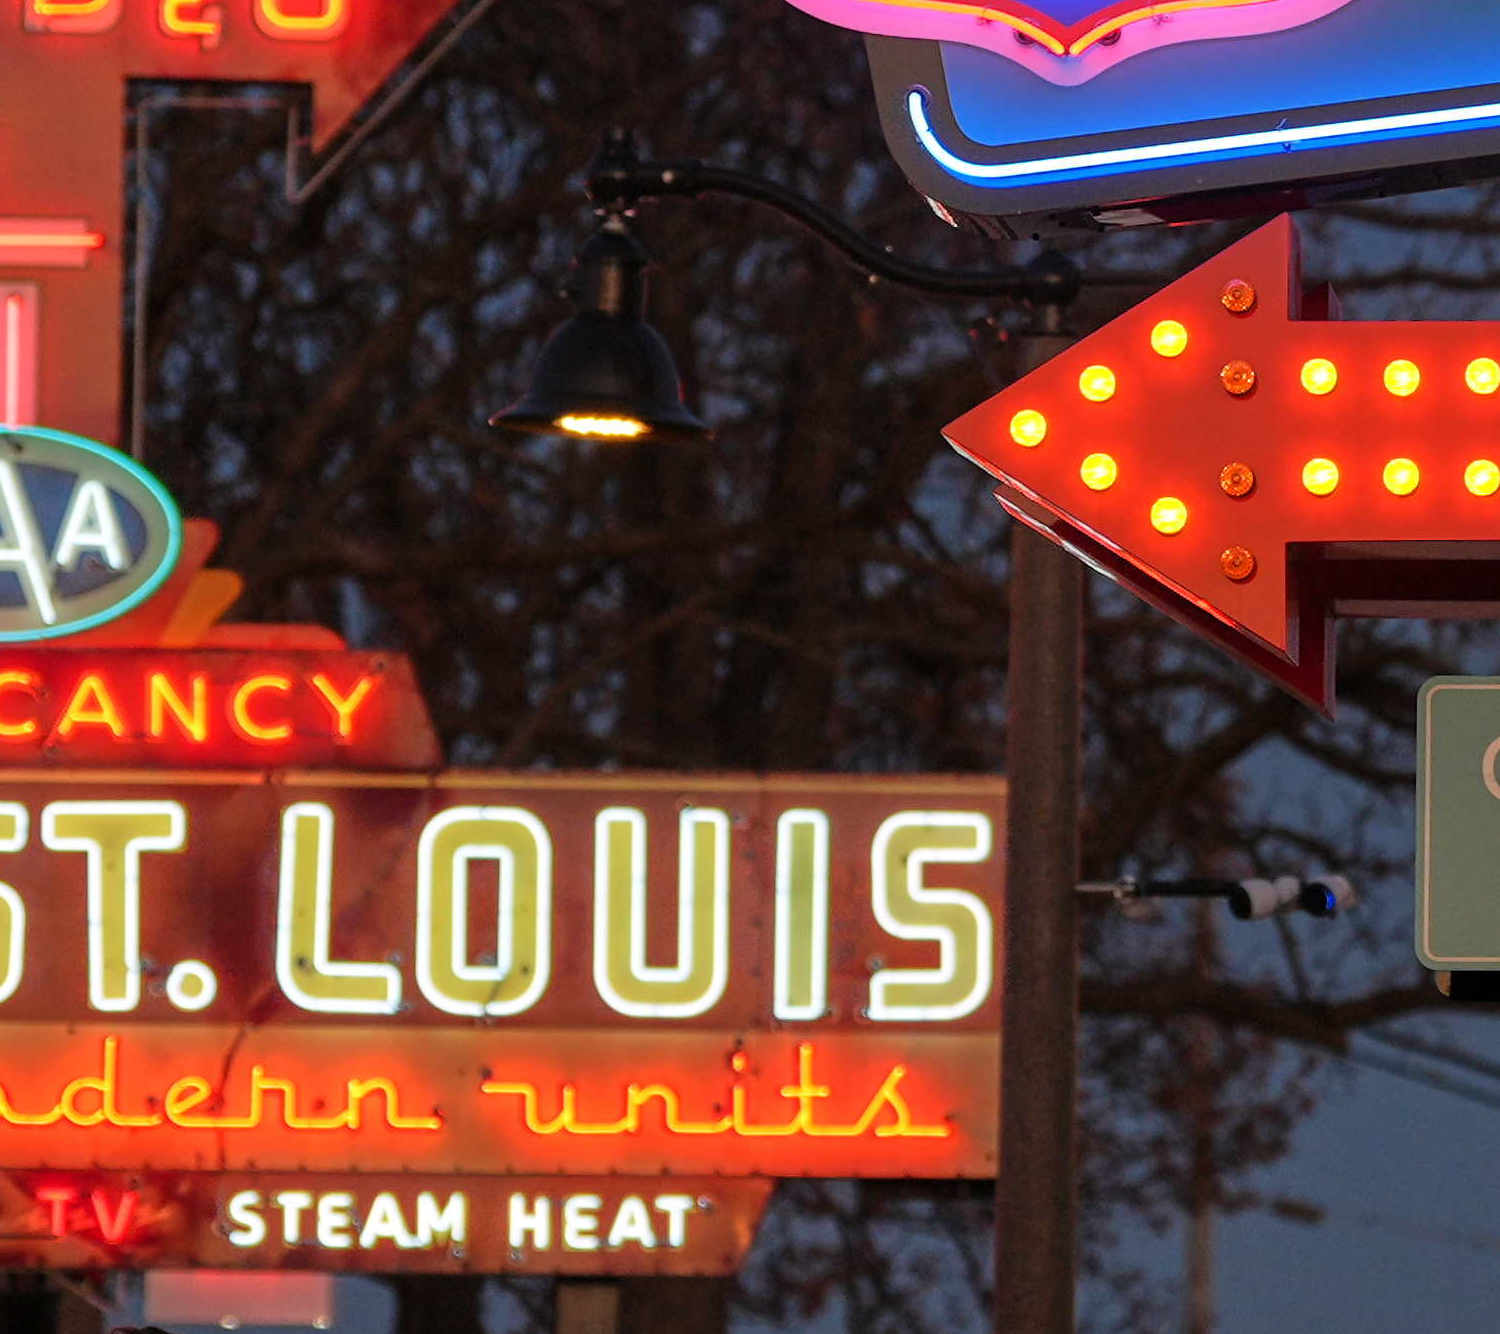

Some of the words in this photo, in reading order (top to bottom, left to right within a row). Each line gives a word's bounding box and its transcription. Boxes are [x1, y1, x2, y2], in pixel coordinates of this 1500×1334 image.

[275, 801, 994, 1021] LOUIS
[482, 1041, 950, 1138] units
[227, 1189, 468, 1250] STEAM
[507, 1192, 696, 1252] HEAT
